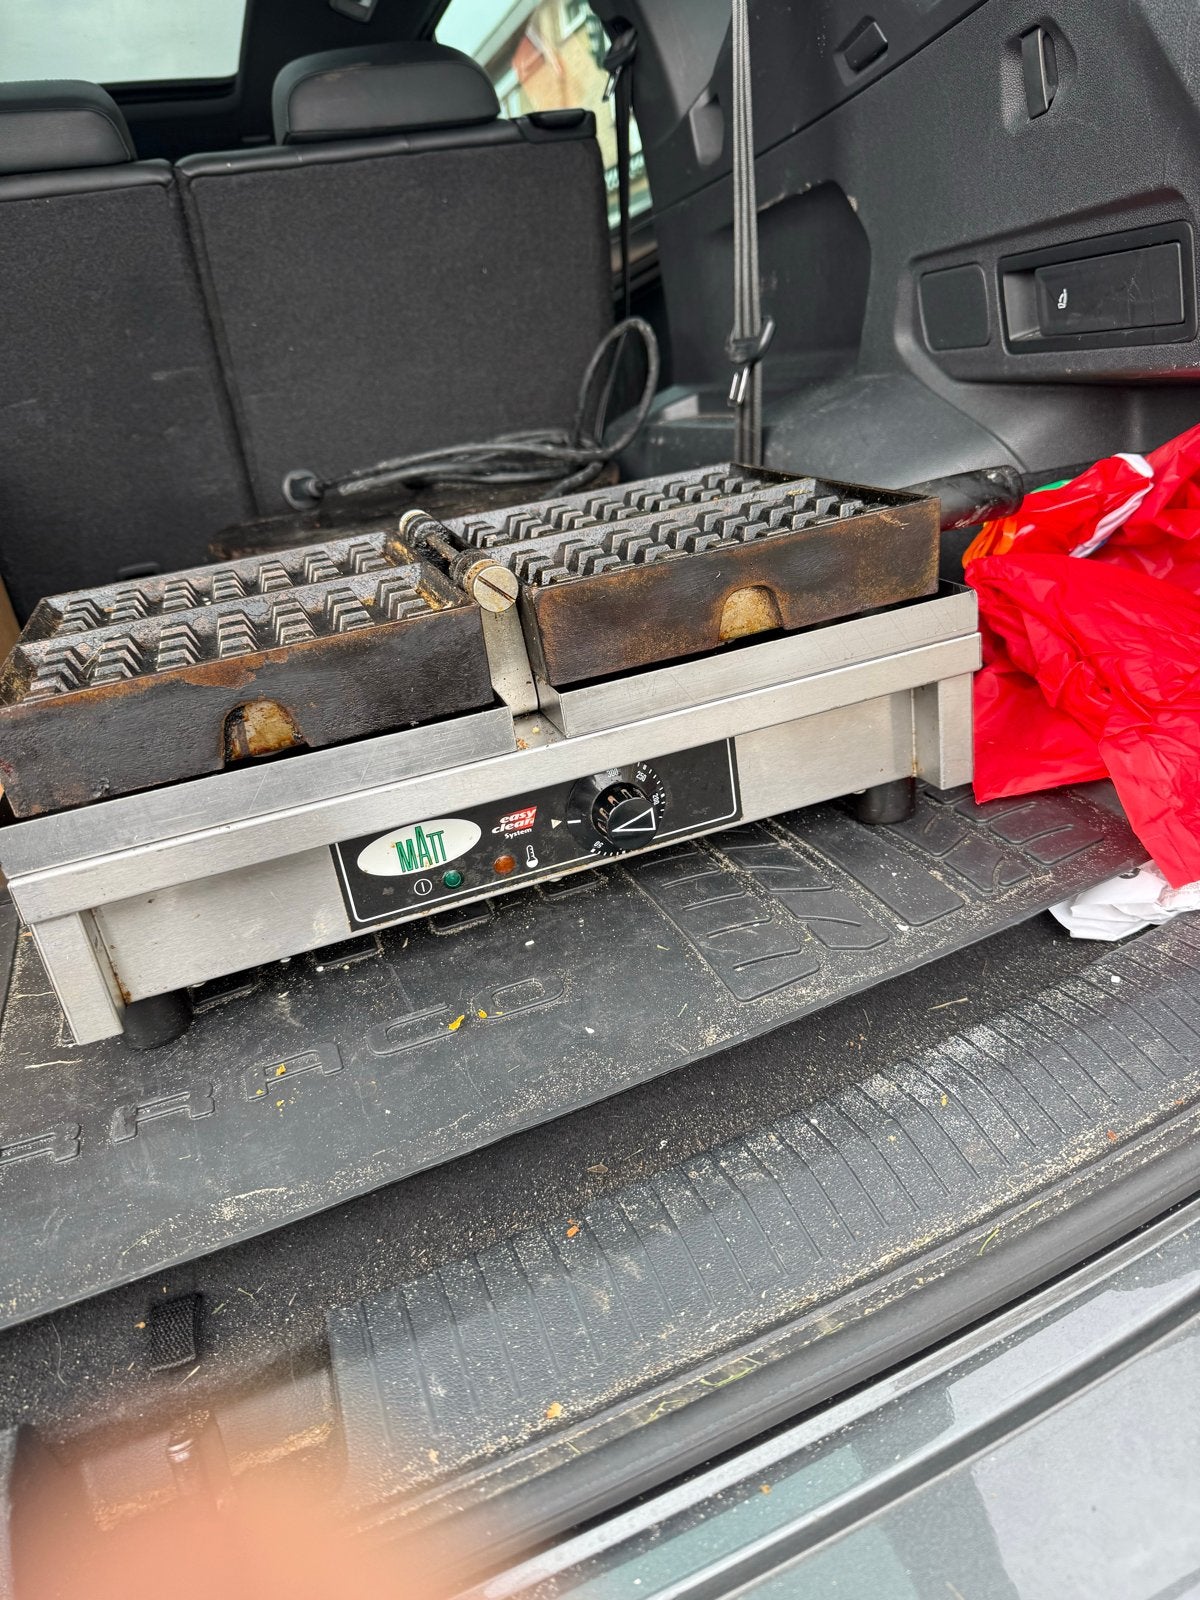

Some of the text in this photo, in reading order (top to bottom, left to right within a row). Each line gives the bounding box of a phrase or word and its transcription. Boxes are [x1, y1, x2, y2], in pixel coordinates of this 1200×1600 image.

[635, 770, 647, 782] 250
[499, 808, 537, 824] easy
[491, 817, 535, 834] clean
[504, 828, 533, 839] System
[395, 825, 447, 873] MATT
